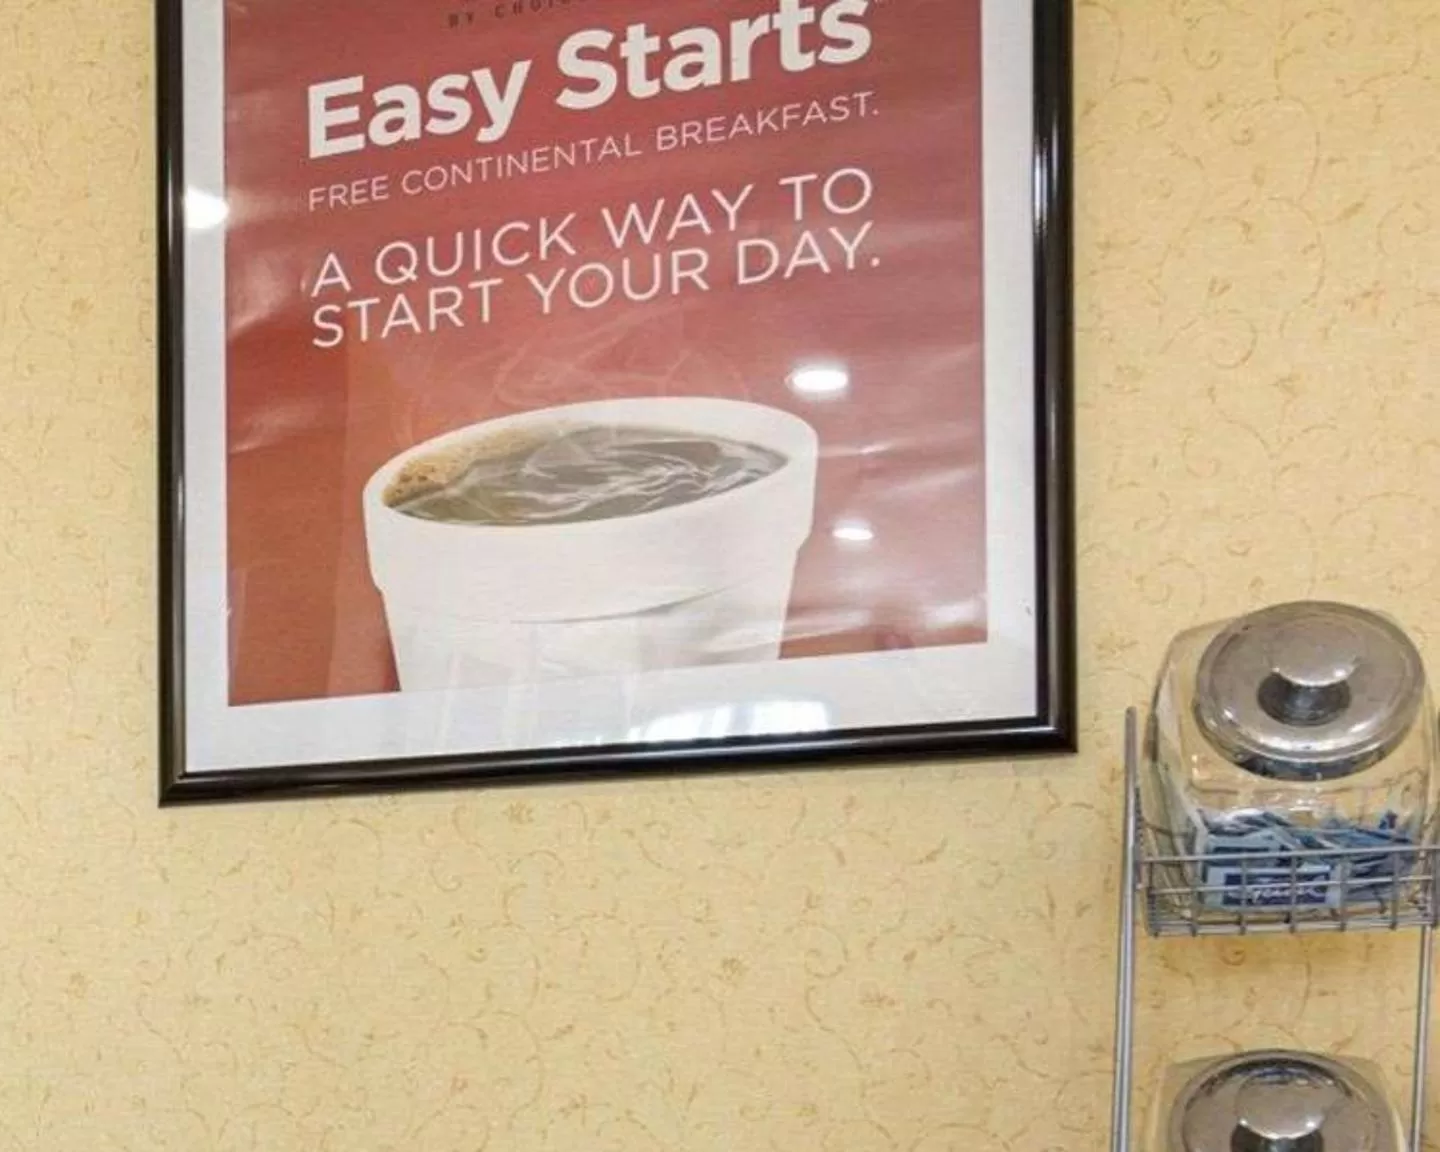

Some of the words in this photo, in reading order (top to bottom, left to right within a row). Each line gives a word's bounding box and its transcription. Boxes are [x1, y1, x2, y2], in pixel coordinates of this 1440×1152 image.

[308, 60, 532, 159] Easy
[556, 0, 872, 110] Starts
[309, 175, 390, 211] FREE
[401, 133, 643, 195] CONTINENTAL
[656, 91, 880, 152] BREAKFAST.
[311, 252, 352, 297] A
[375, 213, 577, 285] QUICK
[601, 183, 754, 249] WAY
[778, 168, 873, 221] TO
[312, 278, 504, 348] START
[526, 247, 709, 314] YOUR
[737, 221, 881, 285] DAY.
